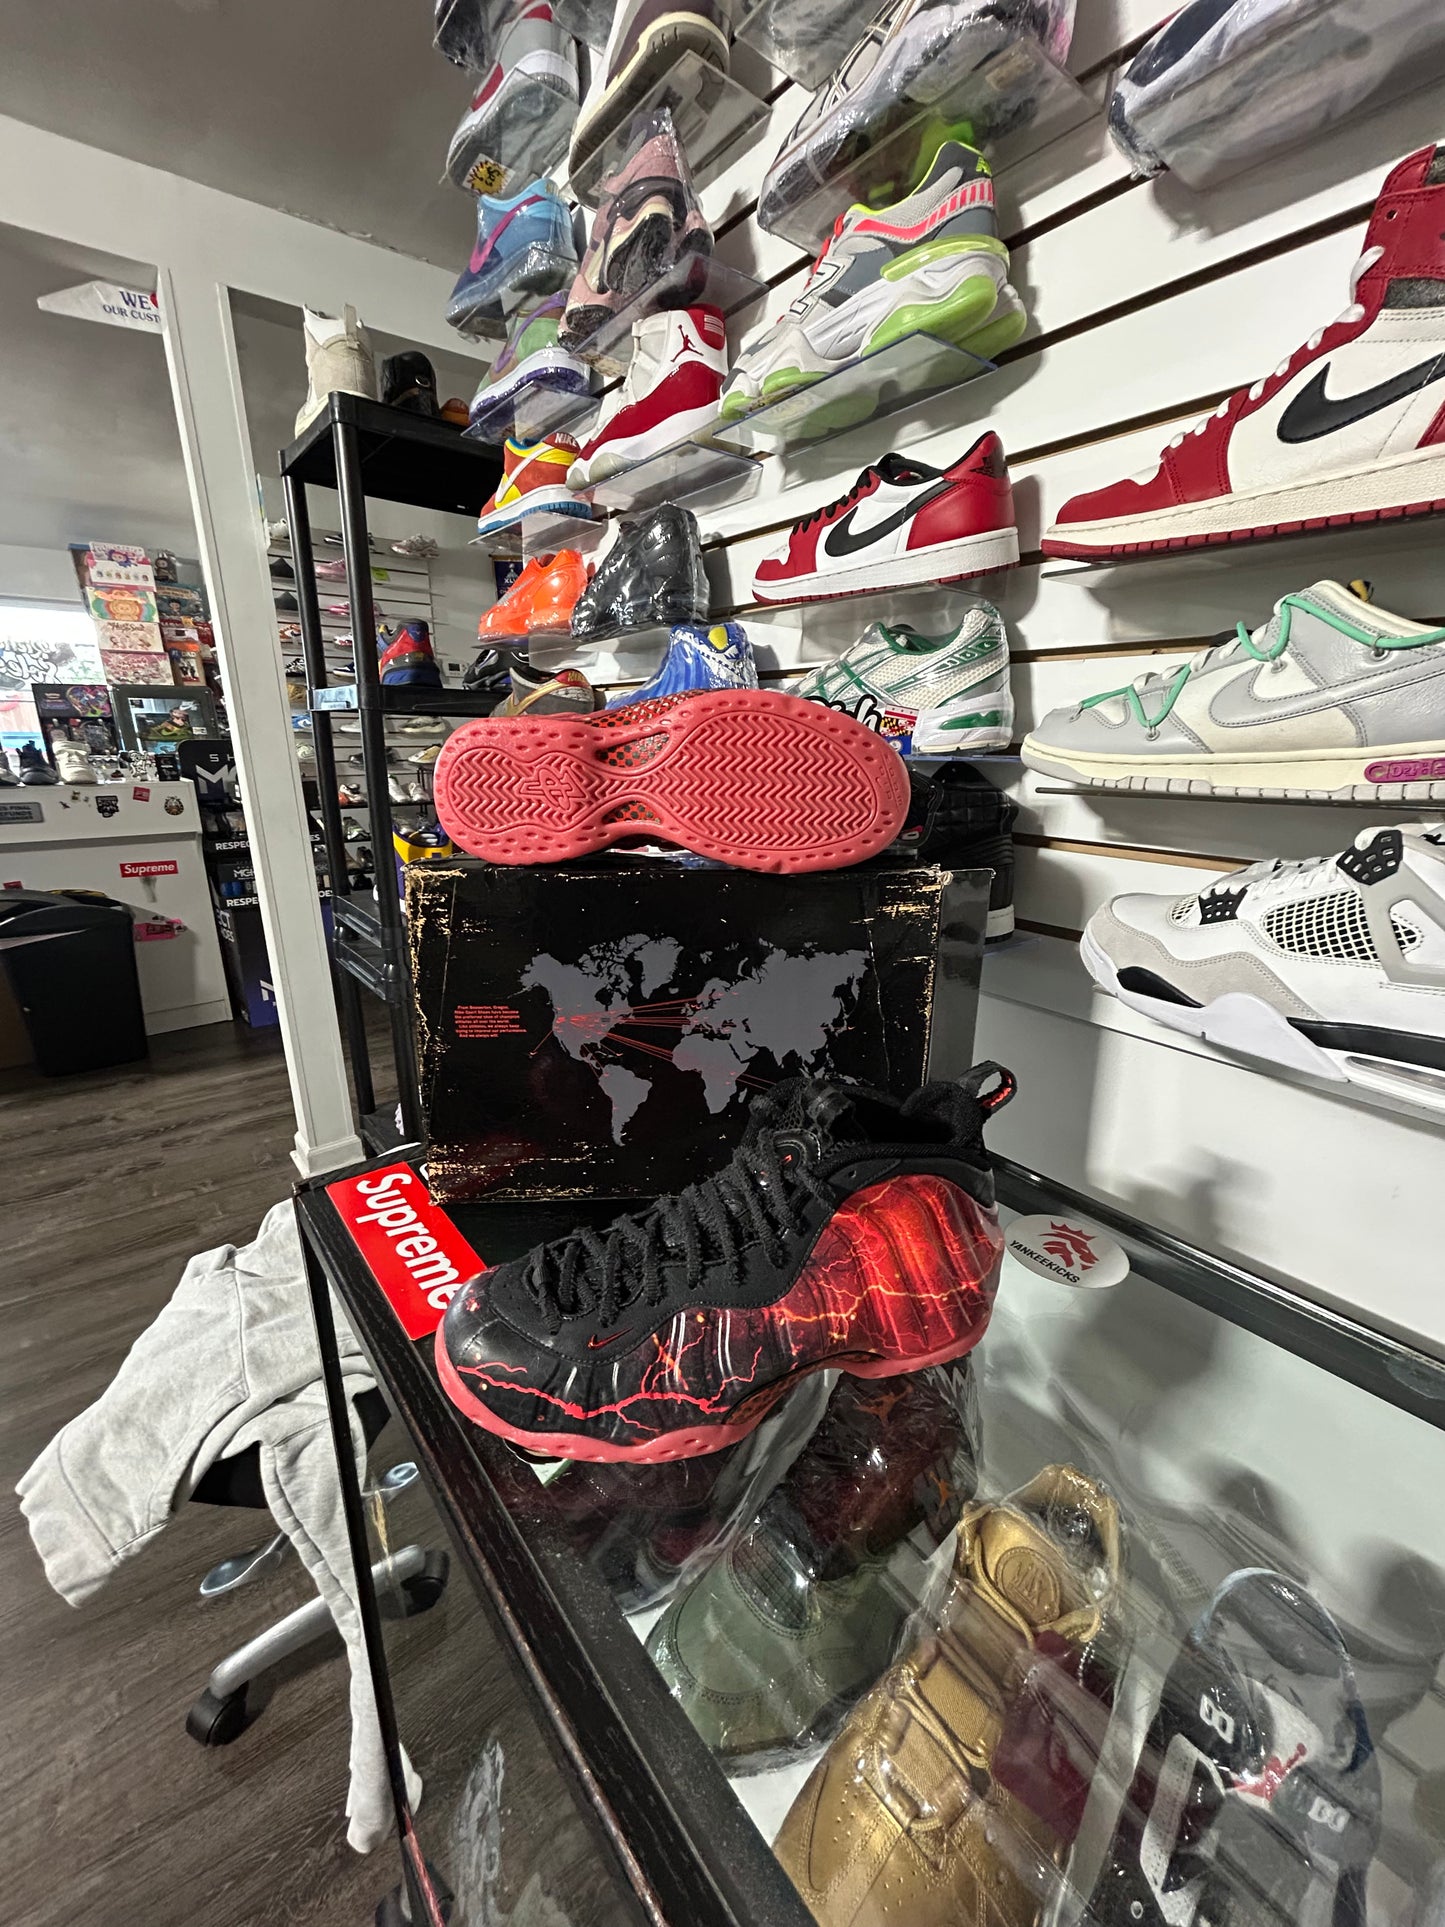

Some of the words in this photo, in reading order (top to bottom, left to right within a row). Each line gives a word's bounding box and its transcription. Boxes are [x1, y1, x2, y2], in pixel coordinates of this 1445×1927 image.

[119, 291, 151, 310] WE
[103, 304, 128, 317] OUR
[124, 864, 175, 876] Supreme
[356, 1173, 464, 1310] Supreme
[1010, 1240, 1080, 1283] YANKEEKICKS
